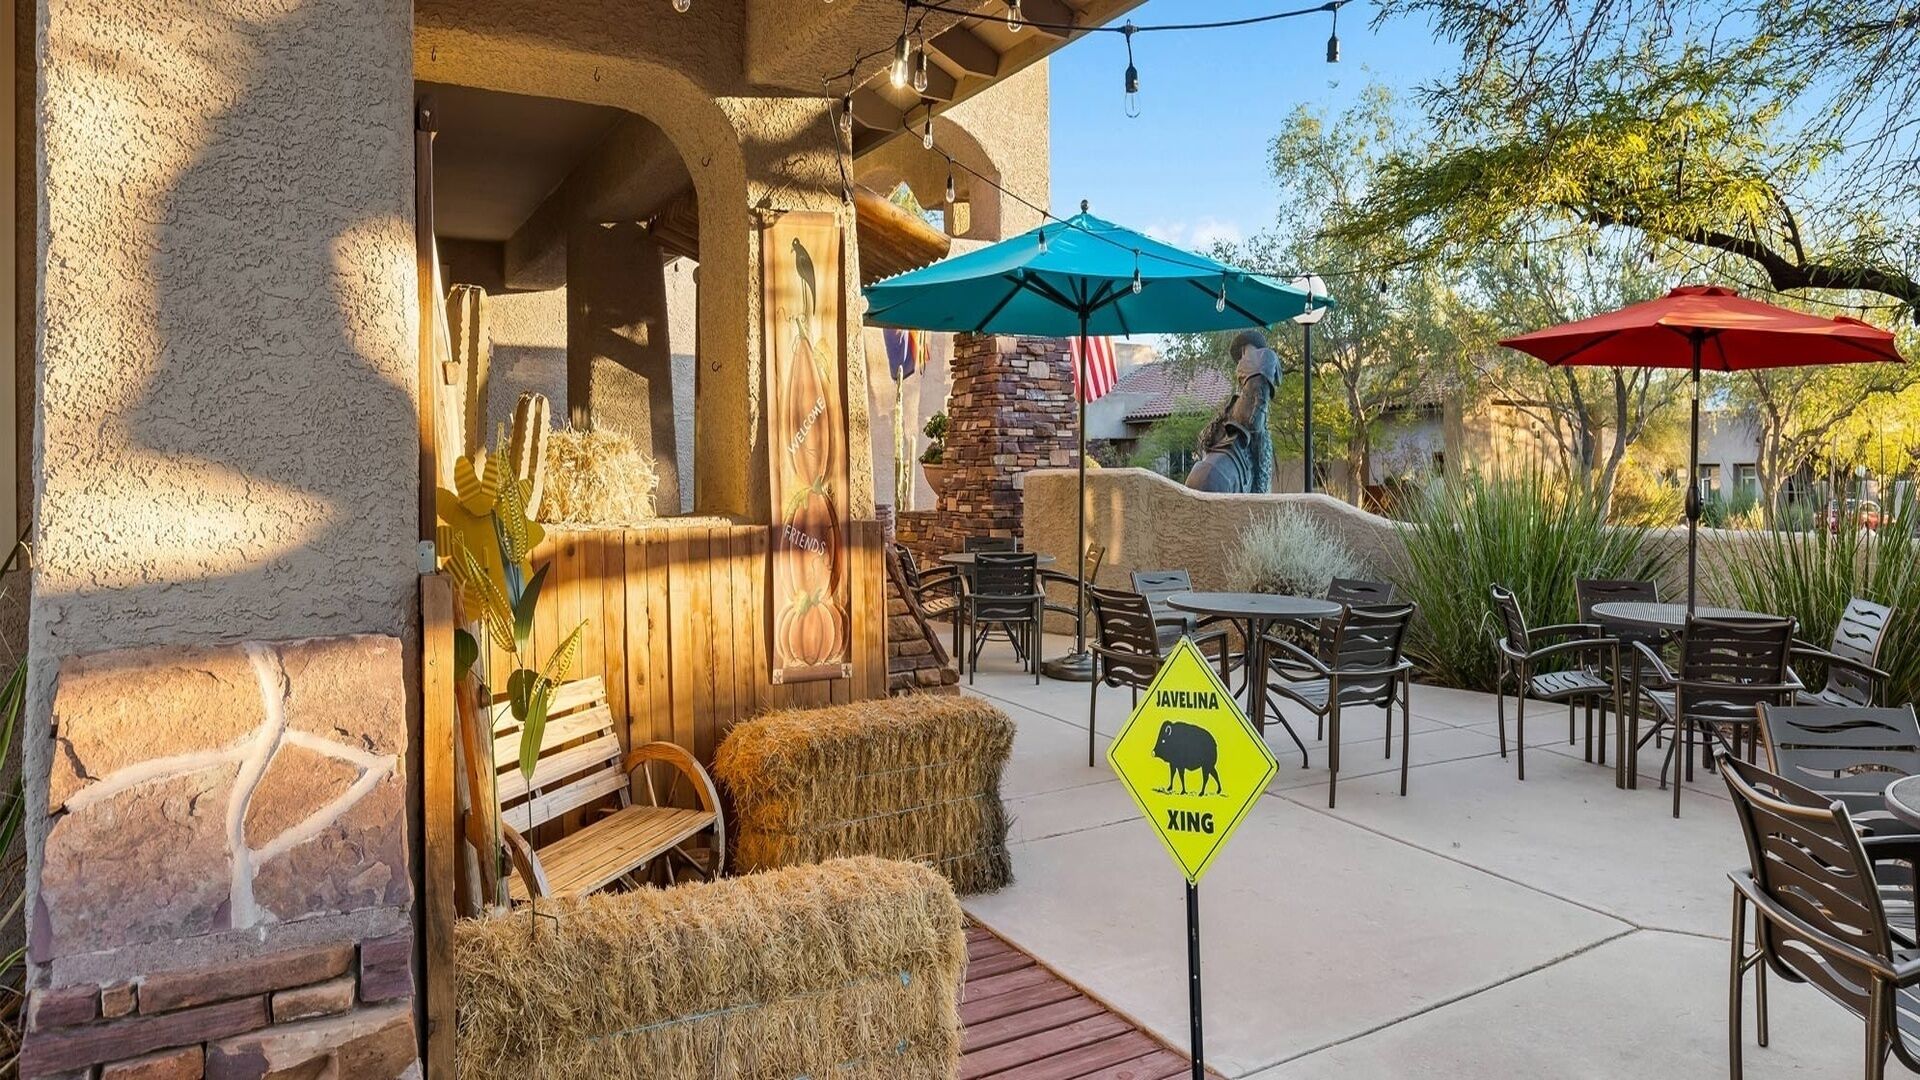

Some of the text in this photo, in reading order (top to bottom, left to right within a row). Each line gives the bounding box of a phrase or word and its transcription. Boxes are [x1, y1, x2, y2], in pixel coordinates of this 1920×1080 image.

[788, 397, 826, 456] WELCOME
[784, 525, 826, 556] FRIENDS
[1156, 690, 1219, 710] JAVELINA
[1167, 810, 1214, 834] XING
